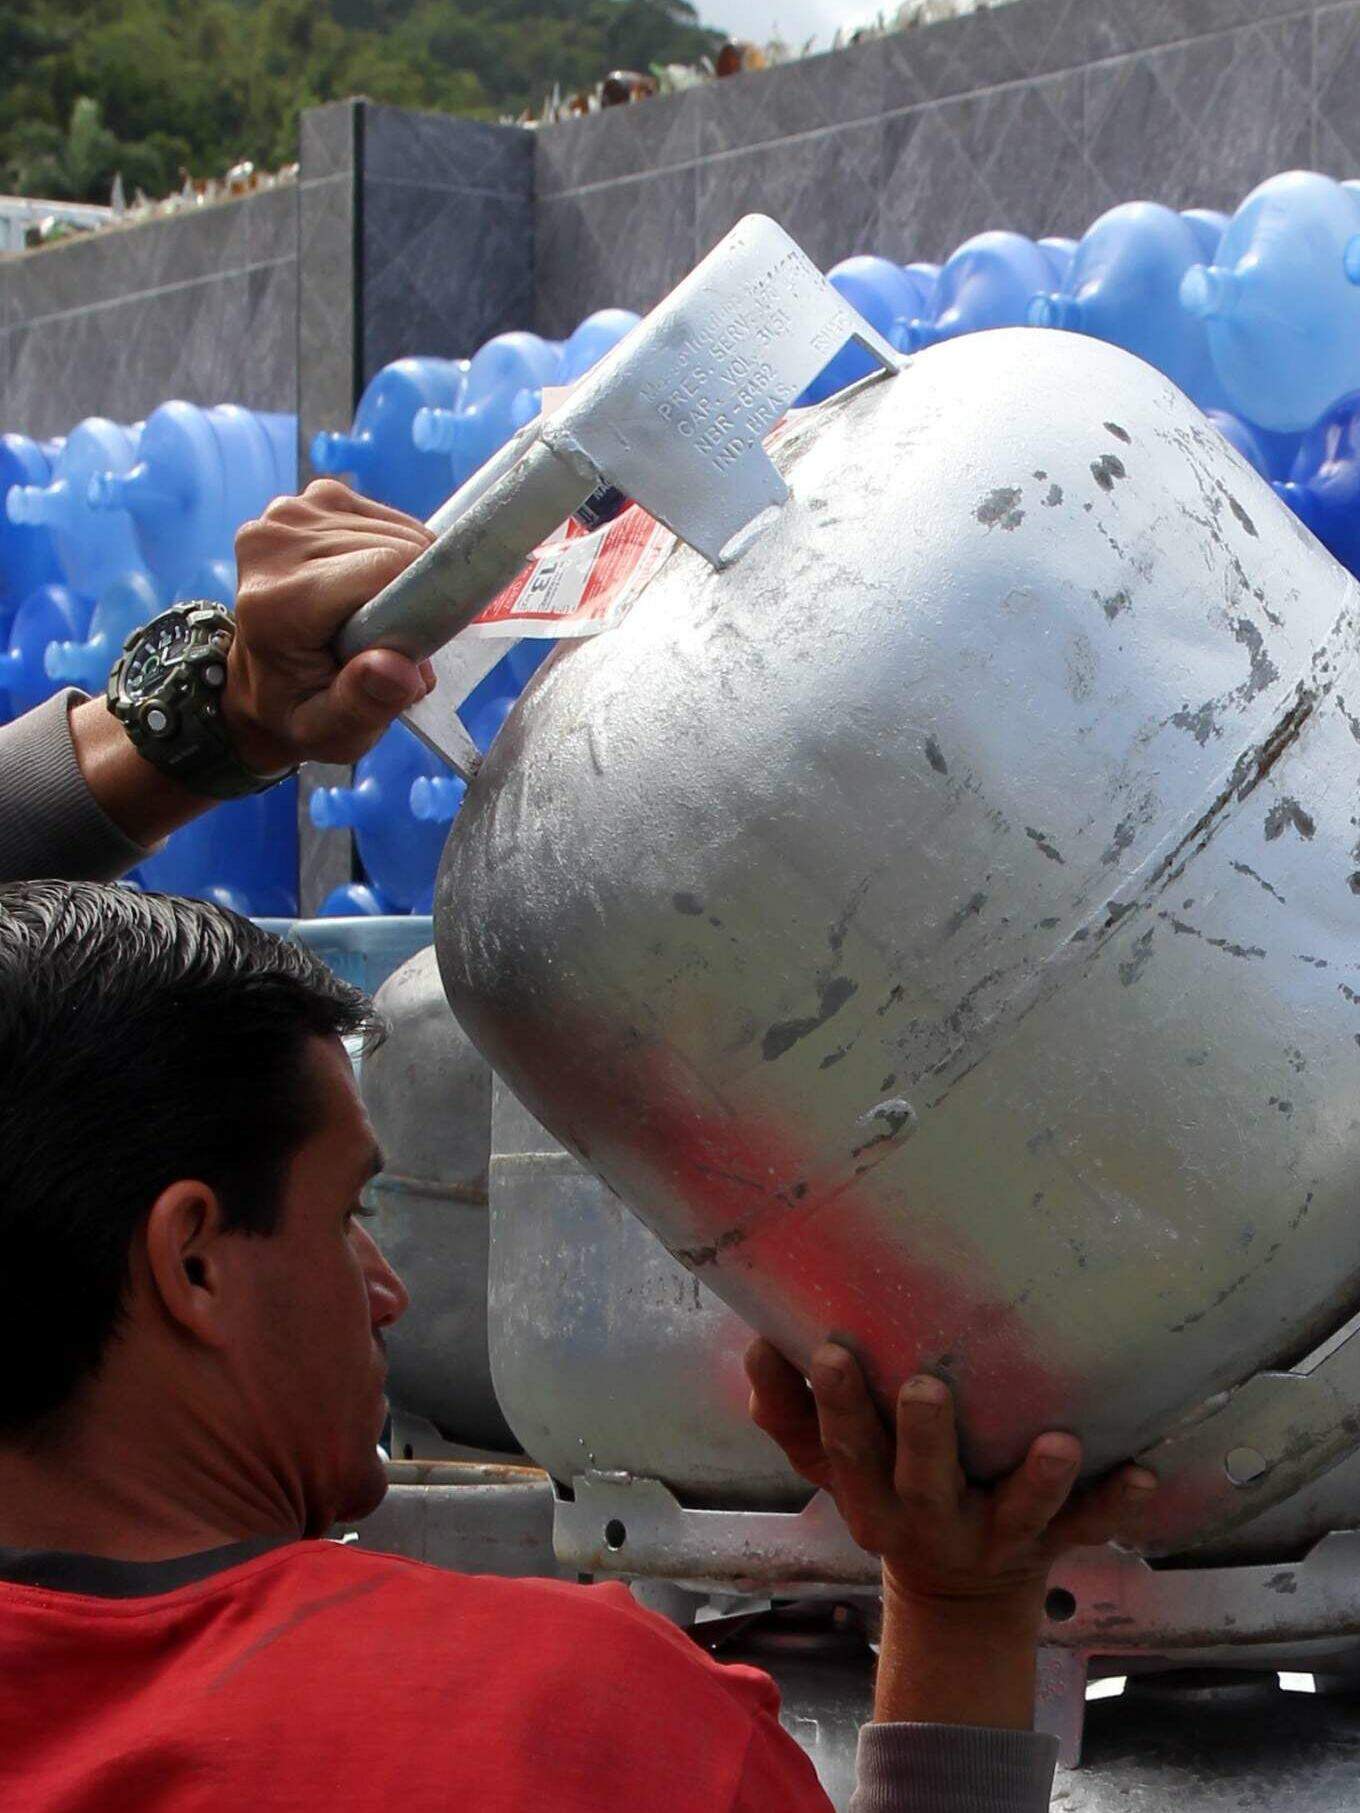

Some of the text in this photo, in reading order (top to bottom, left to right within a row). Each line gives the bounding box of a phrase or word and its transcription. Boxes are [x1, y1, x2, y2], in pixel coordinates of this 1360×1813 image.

[656, 364, 716, 422] PRES.
[675, 395, 723, 439] CAP.
[692, 412, 736, 457] NBR
[532, 562, 552, 592] 13
